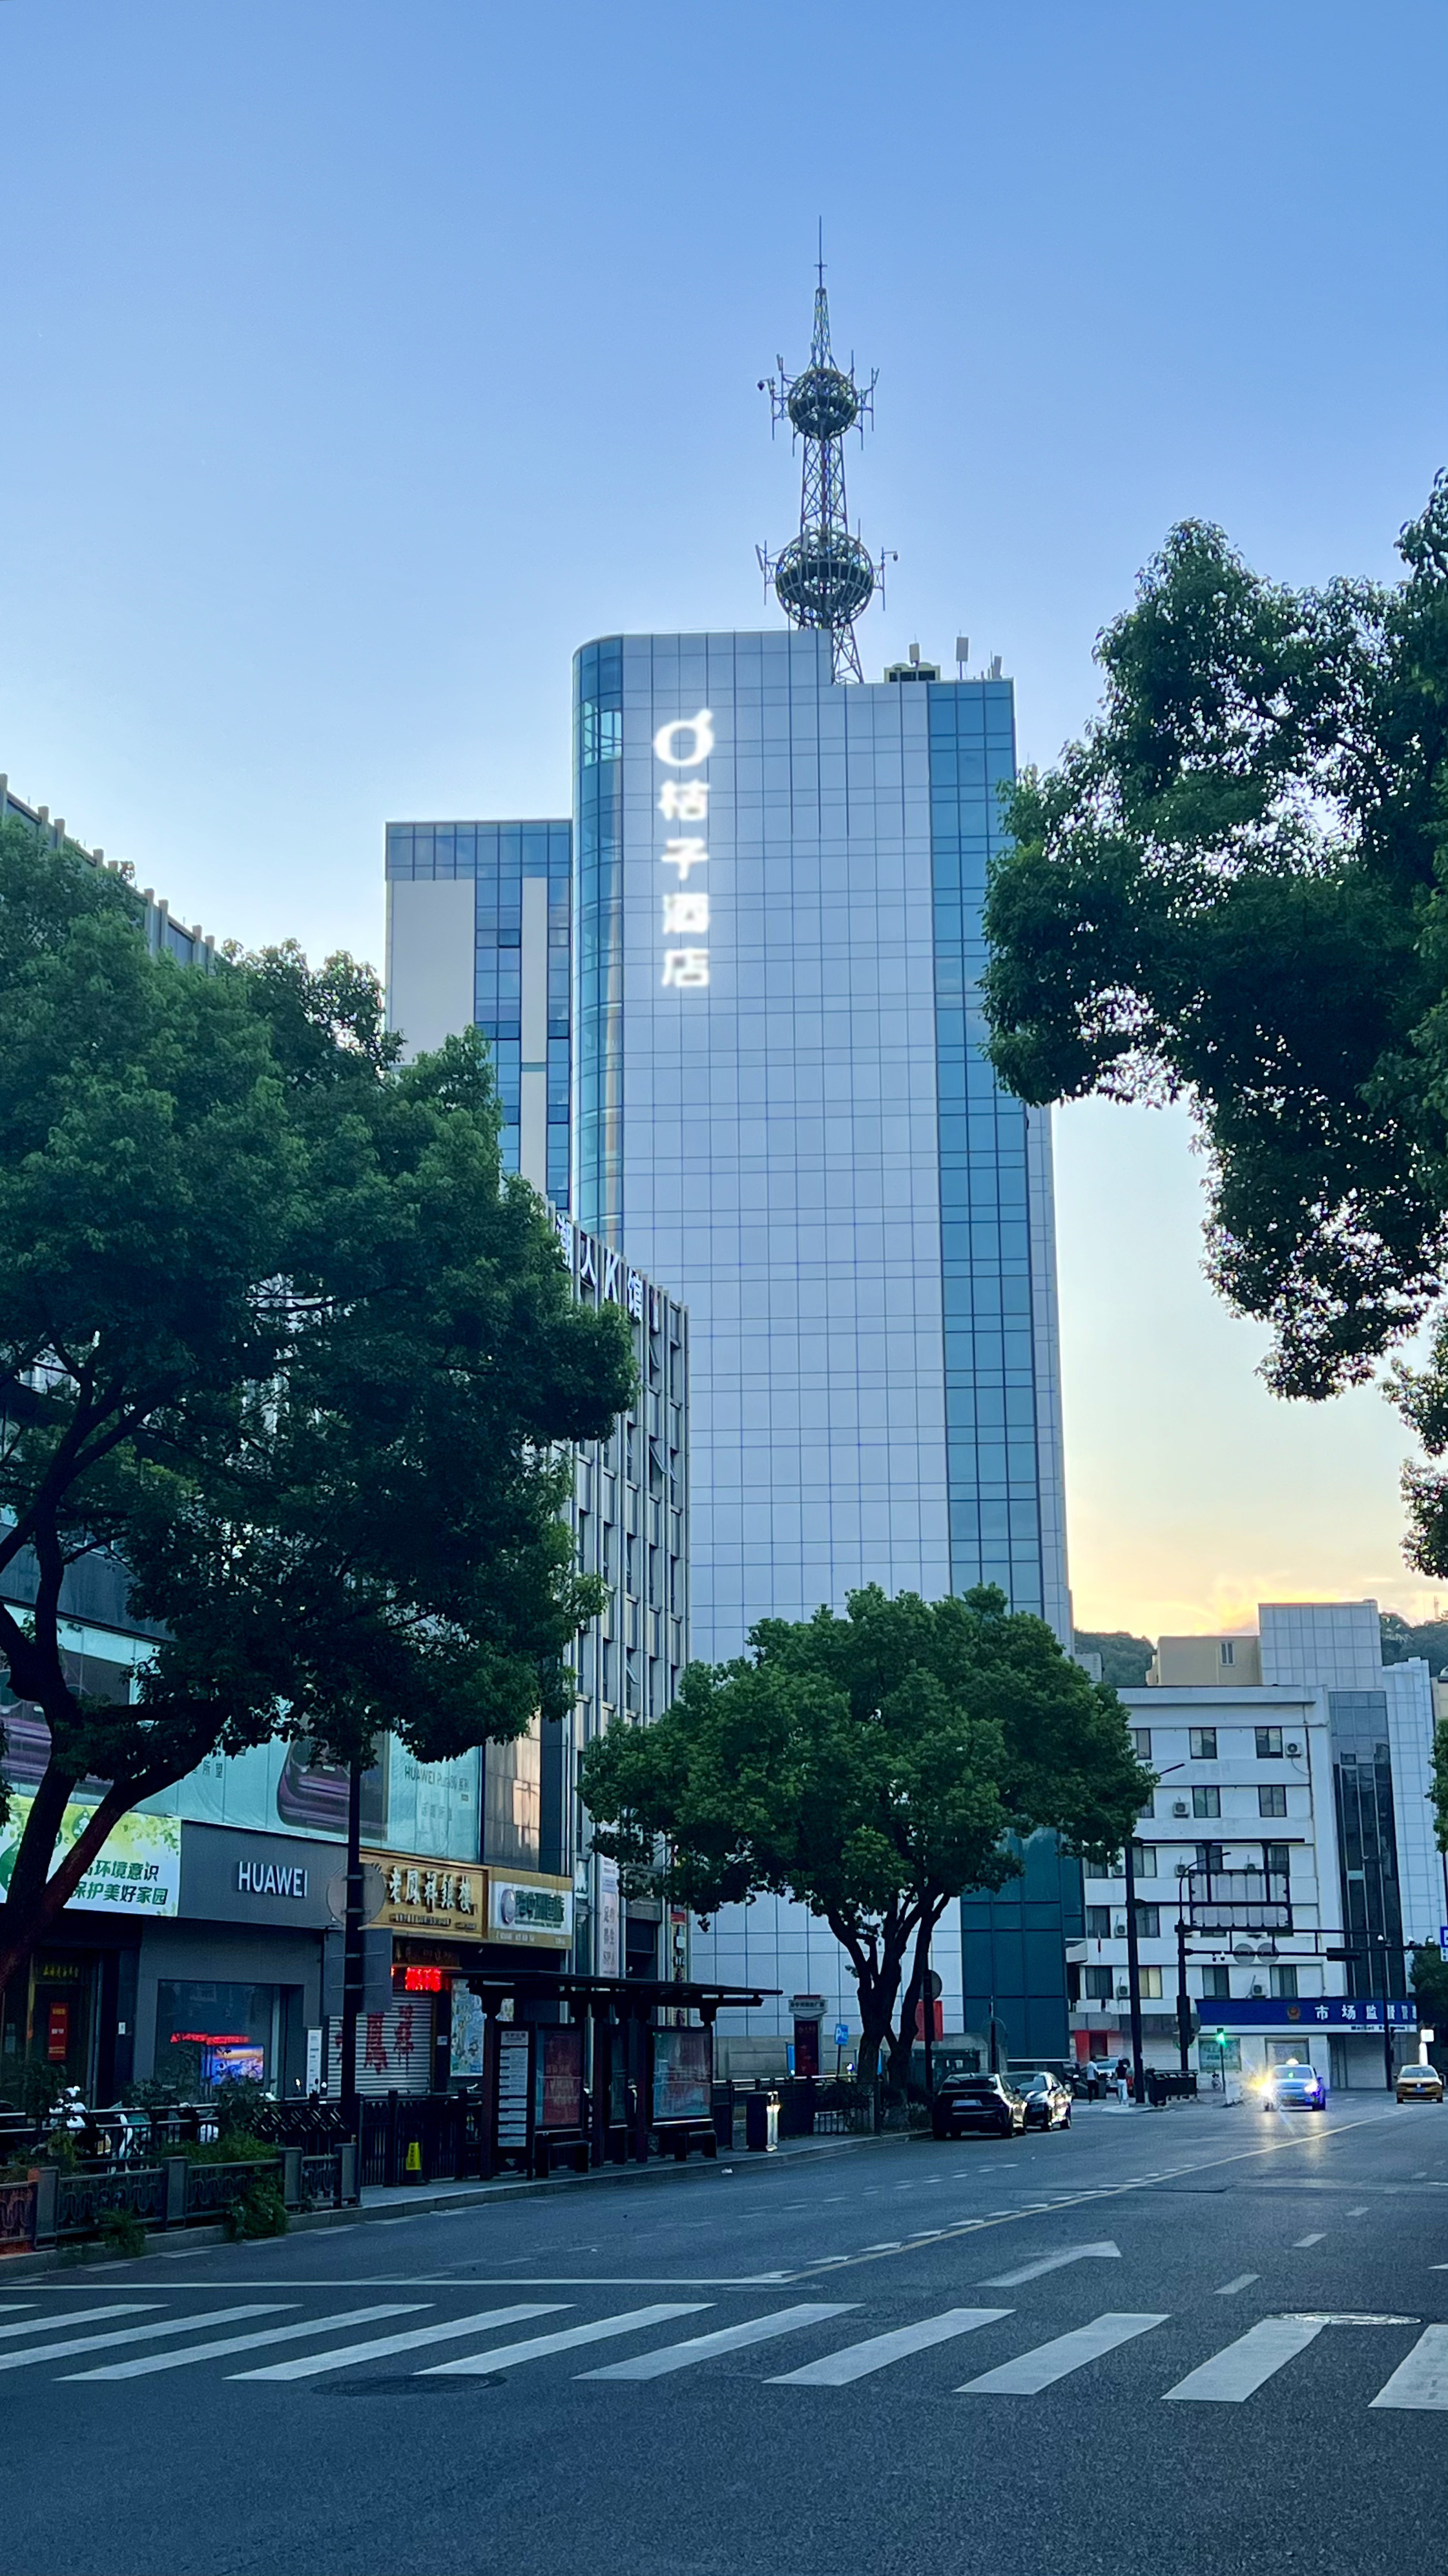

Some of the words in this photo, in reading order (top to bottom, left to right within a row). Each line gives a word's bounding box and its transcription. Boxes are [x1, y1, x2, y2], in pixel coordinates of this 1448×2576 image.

[657, 778, 710, 988] 桔子酒店
[238, 1861, 308, 1898] HUAWEI
